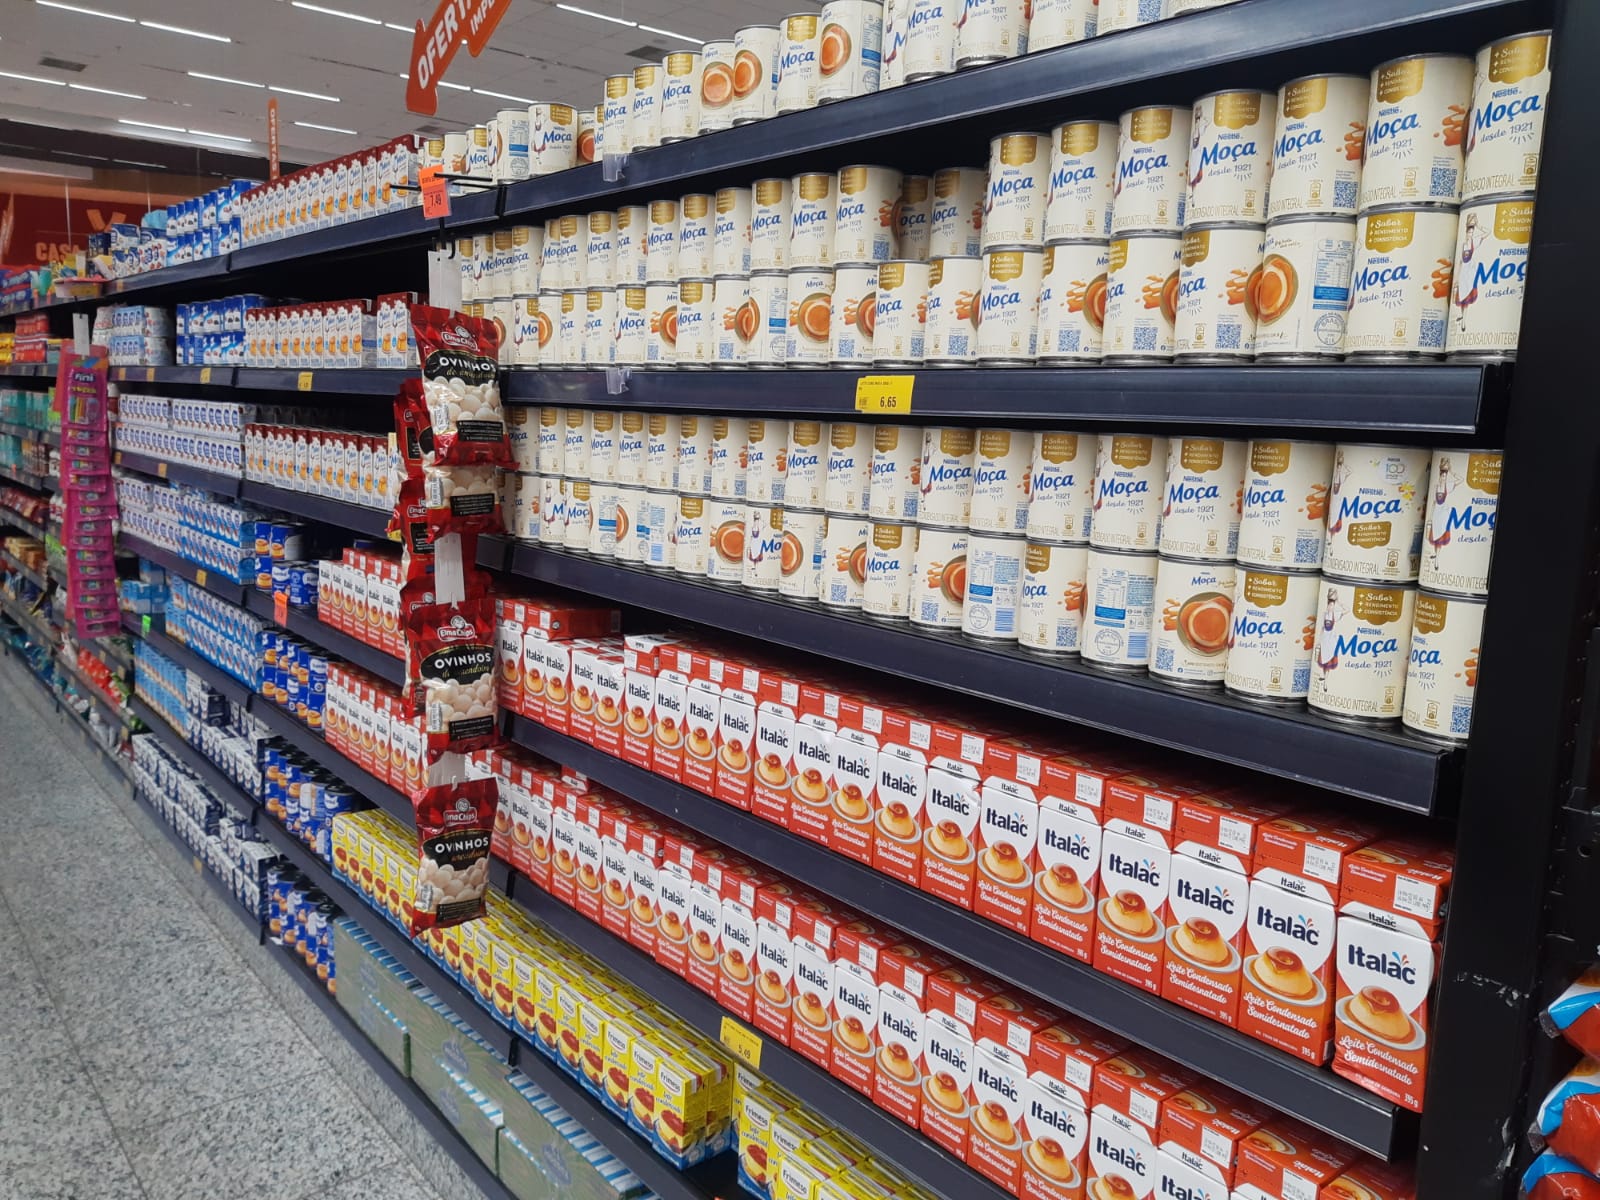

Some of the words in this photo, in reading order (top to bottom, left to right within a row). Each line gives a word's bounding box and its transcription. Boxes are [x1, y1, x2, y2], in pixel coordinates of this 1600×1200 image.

[907, 5, 943, 28] Moça
[780, 51, 815, 69] Moça
[1492, 87, 1519, 99] Nestlé
[1475, 95, 1541, 131] Moça
[543, 131, 572, 145] Moça
[1367, 114, 1420, 145] Moça
[1509, 122, 1533, 134] 1921
[1201, 140, 1257, 165] Moça
[1274, 129, 1323, 159] Moça
[1392, 138, 1412, 150] 1921
[1120, 154, 1169, 178] Moça
[1233, 163, 1252, 173] 1921
[991, 175, 1035, 197] Moça
[1051, 165, 1096, 189] Moça
[752, 214, 782, 229] Moça
[793, 209, 827, 227] Moça
[836, 204, 865, 222] Moça
[647, 231, 673, 244] Moça
[680, 226, 707, 241] Moça
[1354, 265, 1408, 292] Moça
[983, 292, 1020, 311] Moça
[1382, 289, 1402, 299] 1921
[880, 396, 897, 408] 6,65
[787, 454, 818, 468] Moça
[930, 465, 972, 482] Moça
[973, 467, 1007, 484] Moça
[1033, 474, 1074, 491] Moça
[1100, 480, 1149, 497] Moça
[1169, 484, 1219, 503] Moça
[1244, 487, 1285, 507] Moça
[1262, 510, 1279, 518] 1921
[1339, 496, 1401, 518] Moça
[867, 557, 899, 572] Moça
[1191, 575, 1217, 586] Moça
[1365, 593, 1393, 601] Sabor
[1234, 616, 1283, 638] Moça
[1335, 635, 1398, 657] Moça
[434, 653, 491, 669] OVINHOS
[1419, 671, 1435, 680] 1921
[629, 683, 651, 701] Italac
[658, 693, 681, 712] Italac
[689, 703, 714, 722] Italac
[724, 713, 750, 734] Italac
[760, 727, 789, 749] Italac
[799, 741, 831, 764] Italac
[837, 755, 870, 778] Italac
[882, 771, 917, 797] Italac
[932, 789, 970, 816] Italac
[986, 808, 1028, 837] Italac
[1125, 826, 1146, 839] Italac
[1045, 829, 1090, 860] Italac
[605, 856, 627, 876] Italac
[1198, 849, 1221, 864] Italac
[1109, 854, 1160, 887] Italac
[633, 871, 655, 892] Italac
[1280, 877, 1306, 893] Italac
[661, 886, 685, 907] Italac
[1177, 879, 1234, 915] Italac
[693, 904, 717, 928] Italac
[1257, 906, 1319, 945] Italac
[1369, 912, 1396, 927] Italac
[724, 922, 751, 947] Italac
[761, 943, 788, 968] Italac
[1115, 938, 1158, 963] Condensado
[1348, 944, 1416, 985] Italac
[798, 964, 828, 991] Italac
[1186, 969, 1233, 994] Condensado
[1169, 974, 1227, 1005] Semidesnatado
[839, 986, 872, 1015] Italac
[1243, 992, 1265, 1010] Leite
[1264, 1000, 1318, 1029] Condensado
[883, 1011, 917, 1042] Italac
[1247, 1006, 1310, 1040] Semidesnatado
[634, 1051, 653, 1070] Frimesa
[931, 1039, 967, 1073] Italac
[1339, 1035, 1365, 1050] Leite
[1366, 1042, 1418, 1074] Condensado
[1344, 1049, 1413, 1085] Semidesnatado
[660, 1071, 681, 1093] Frimesa
[979, 1067, 1018, 1102] Italac
[745, 1105, 768, 1125] Frimesa
[1031, 1101, 1076, 1138] Italac
[1112, 1113, 1132, 1131] Italac
[1097, 1137, 1146, 1177] Italac
[1182, 1151, 1203, 1170] Italac
[783, 1169, 807, 1194] Frimesa
